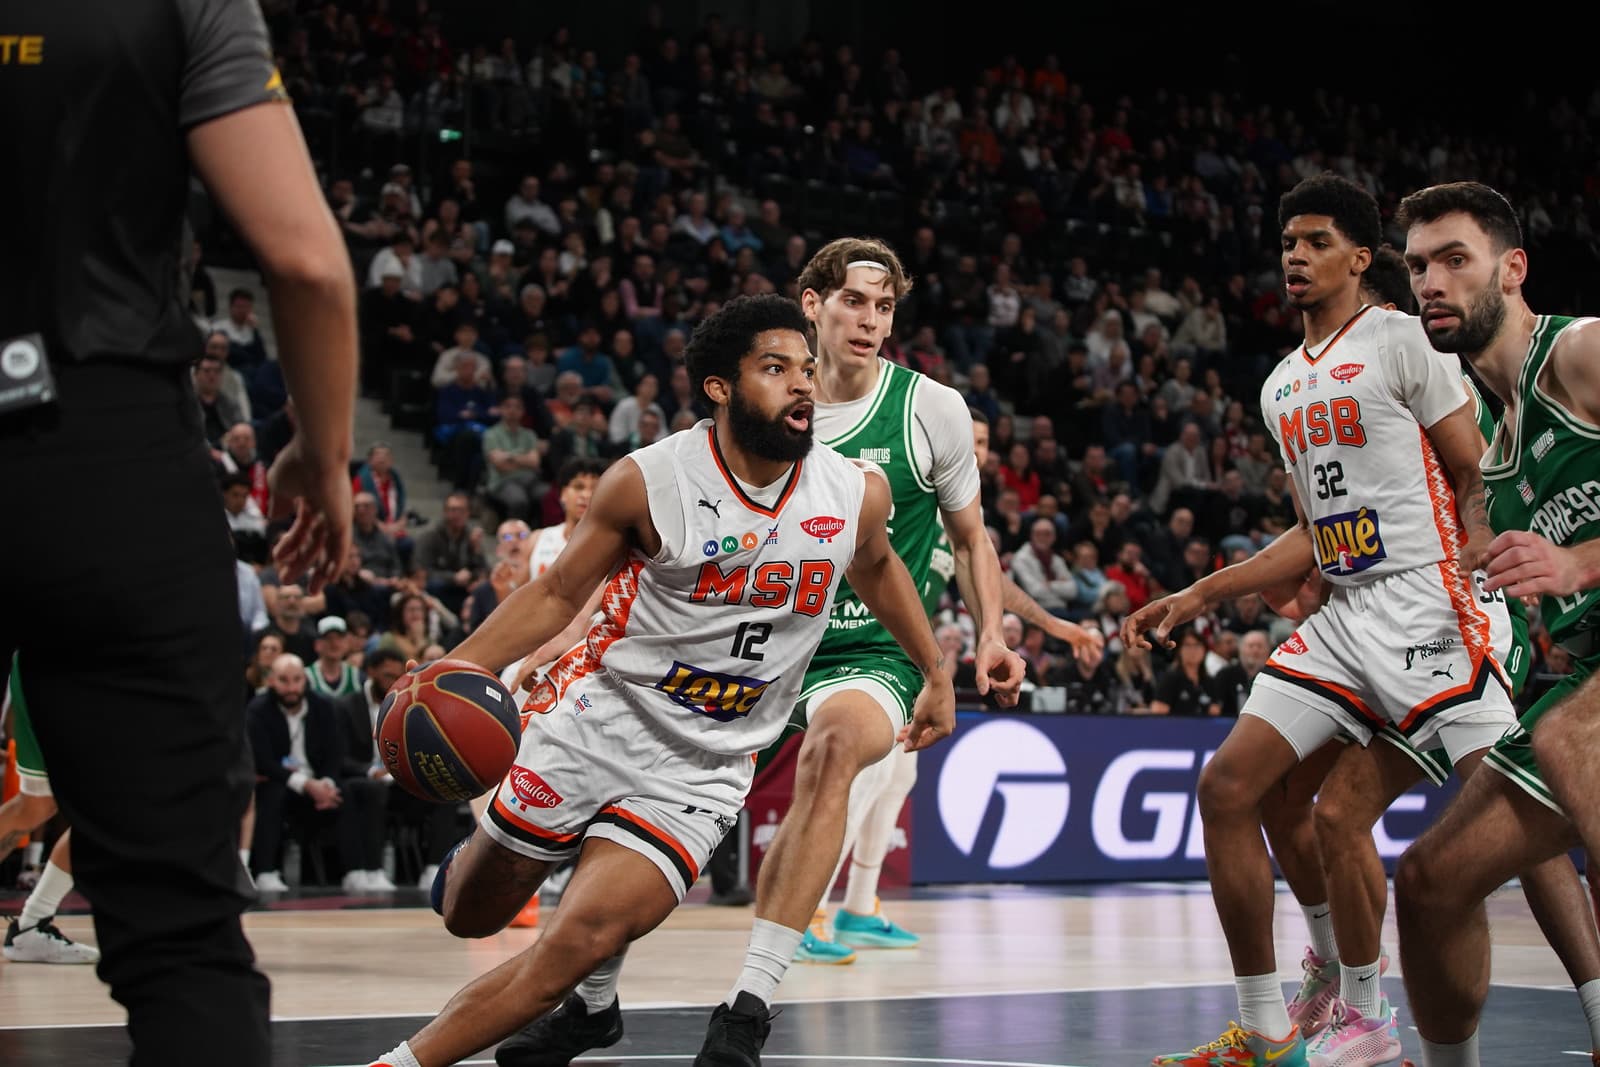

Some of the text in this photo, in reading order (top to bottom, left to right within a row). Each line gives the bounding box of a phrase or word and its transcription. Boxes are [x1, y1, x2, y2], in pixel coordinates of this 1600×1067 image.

[1279, 396, 1367, 466] MSB
[1314, 460, 1348, 500] 32
[809, 519, 844, 534] Gaulois
[689, 559, 835, 618] MSB
[730, 622, 773, 662] 12
[515, 771, 557, 807] Gaulois
